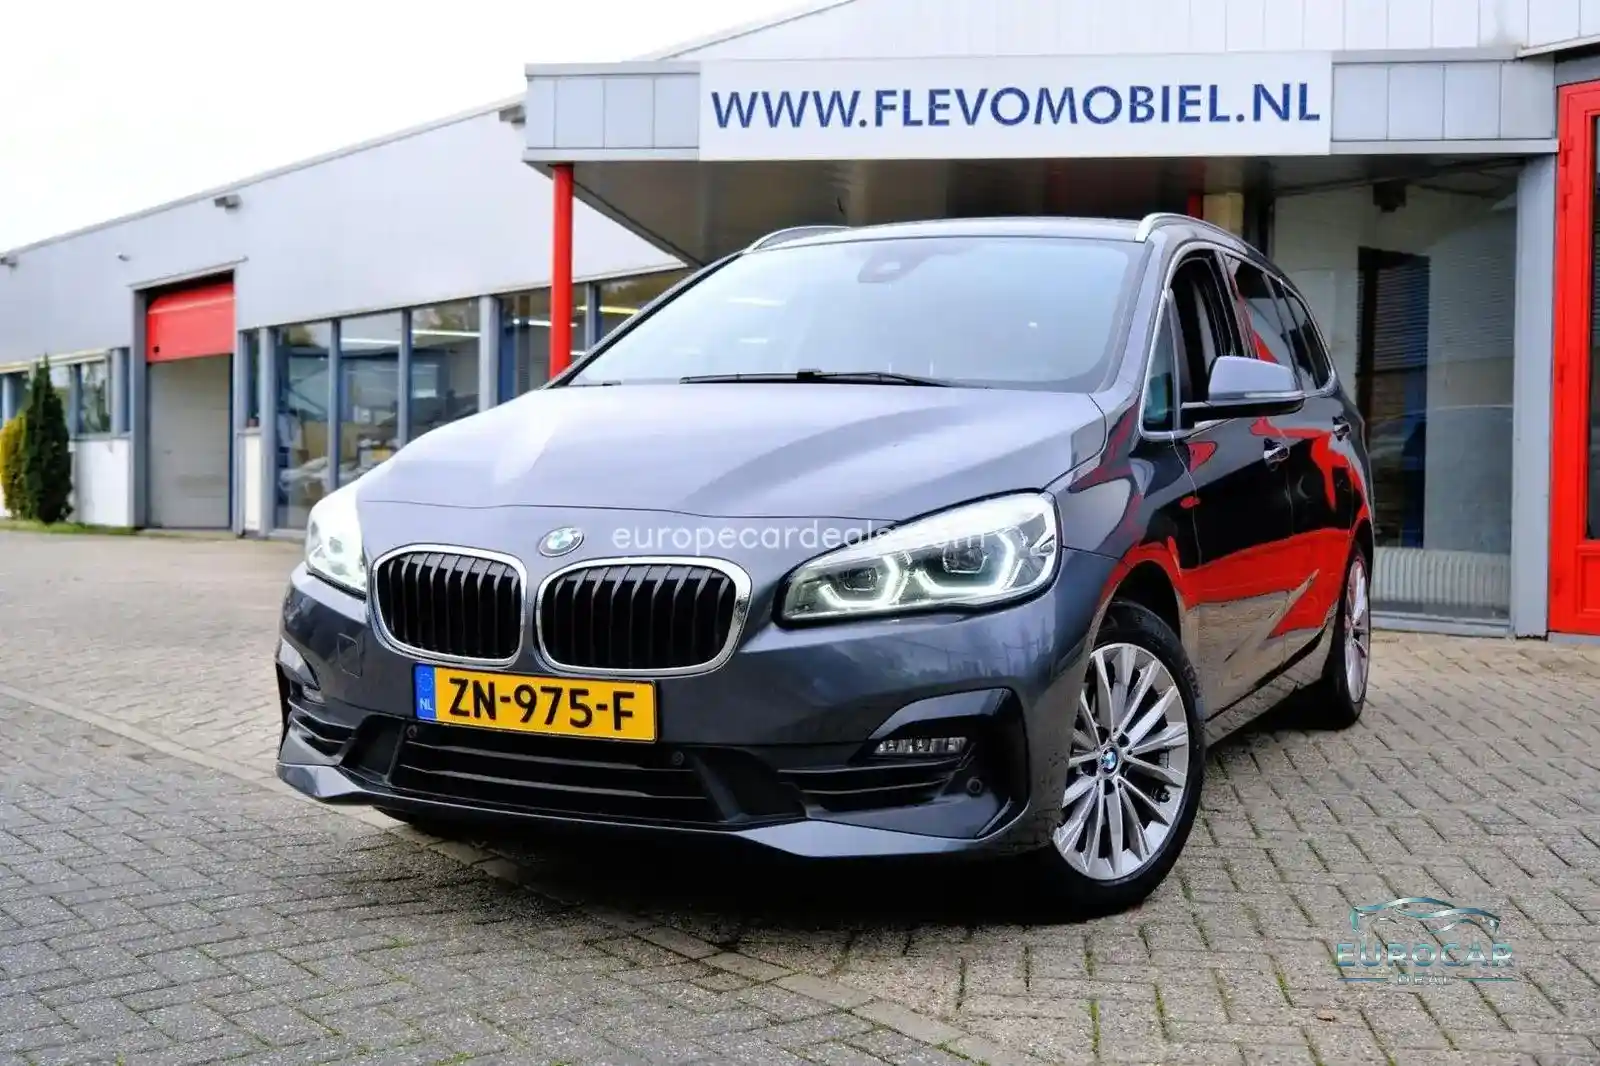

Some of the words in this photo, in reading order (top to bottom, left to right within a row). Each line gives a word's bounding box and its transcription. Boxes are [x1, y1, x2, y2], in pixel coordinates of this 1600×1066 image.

[711, 83, 1321, 129] WWW.FLEVOMOBIEL.NL
[419, 697, 434, 712] NL
[449, 677, 635, 731] ZN-975-F
